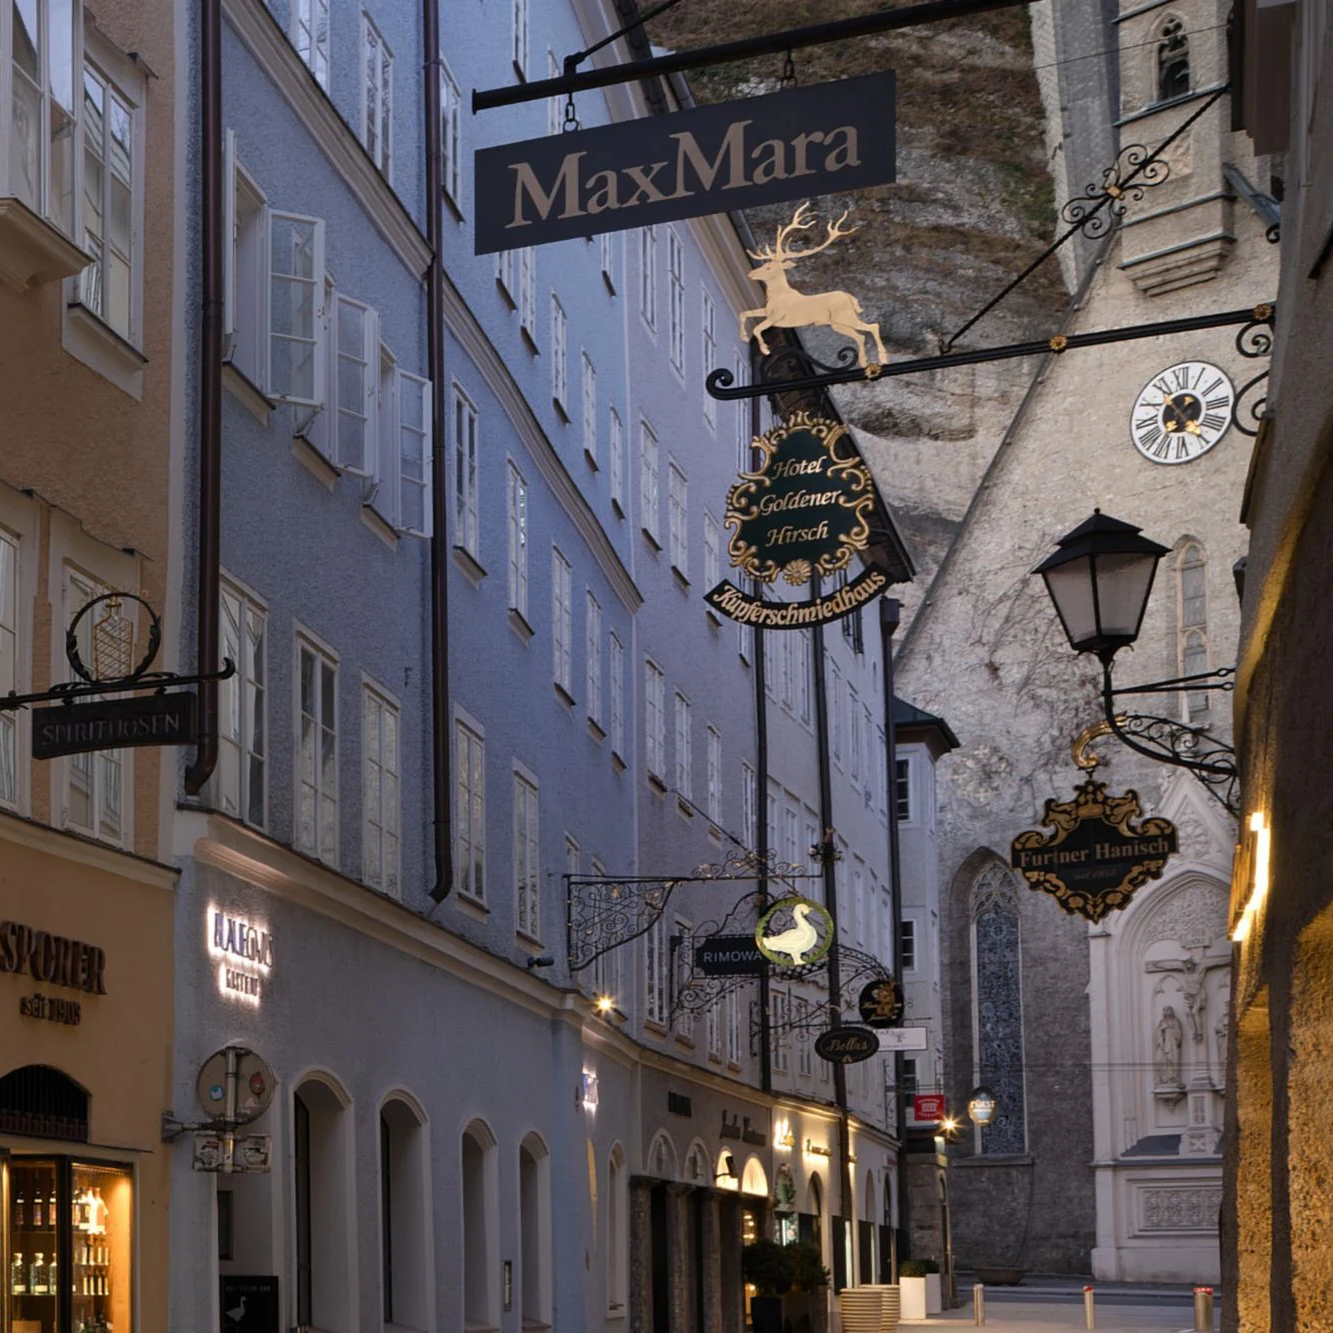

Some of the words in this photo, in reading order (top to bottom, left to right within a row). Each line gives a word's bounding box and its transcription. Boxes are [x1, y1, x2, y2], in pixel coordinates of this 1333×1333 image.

[505, 119, 862, 229] MaxMara
[772, 456, 827, 480] Hotel
[760, 489, 842, 516] Goldener
[765, 520, 829, 547] Hirsch
[713, 571, 886, 625] Kupferschmiedhaus
[41, 712, 180, 746] SPIRITUOSEN
[1020, 849, 1090, 868] Furtner
[1094, 838, 1169, 860] Hanisch
[703, 951, 763, 963] RIMOWA
